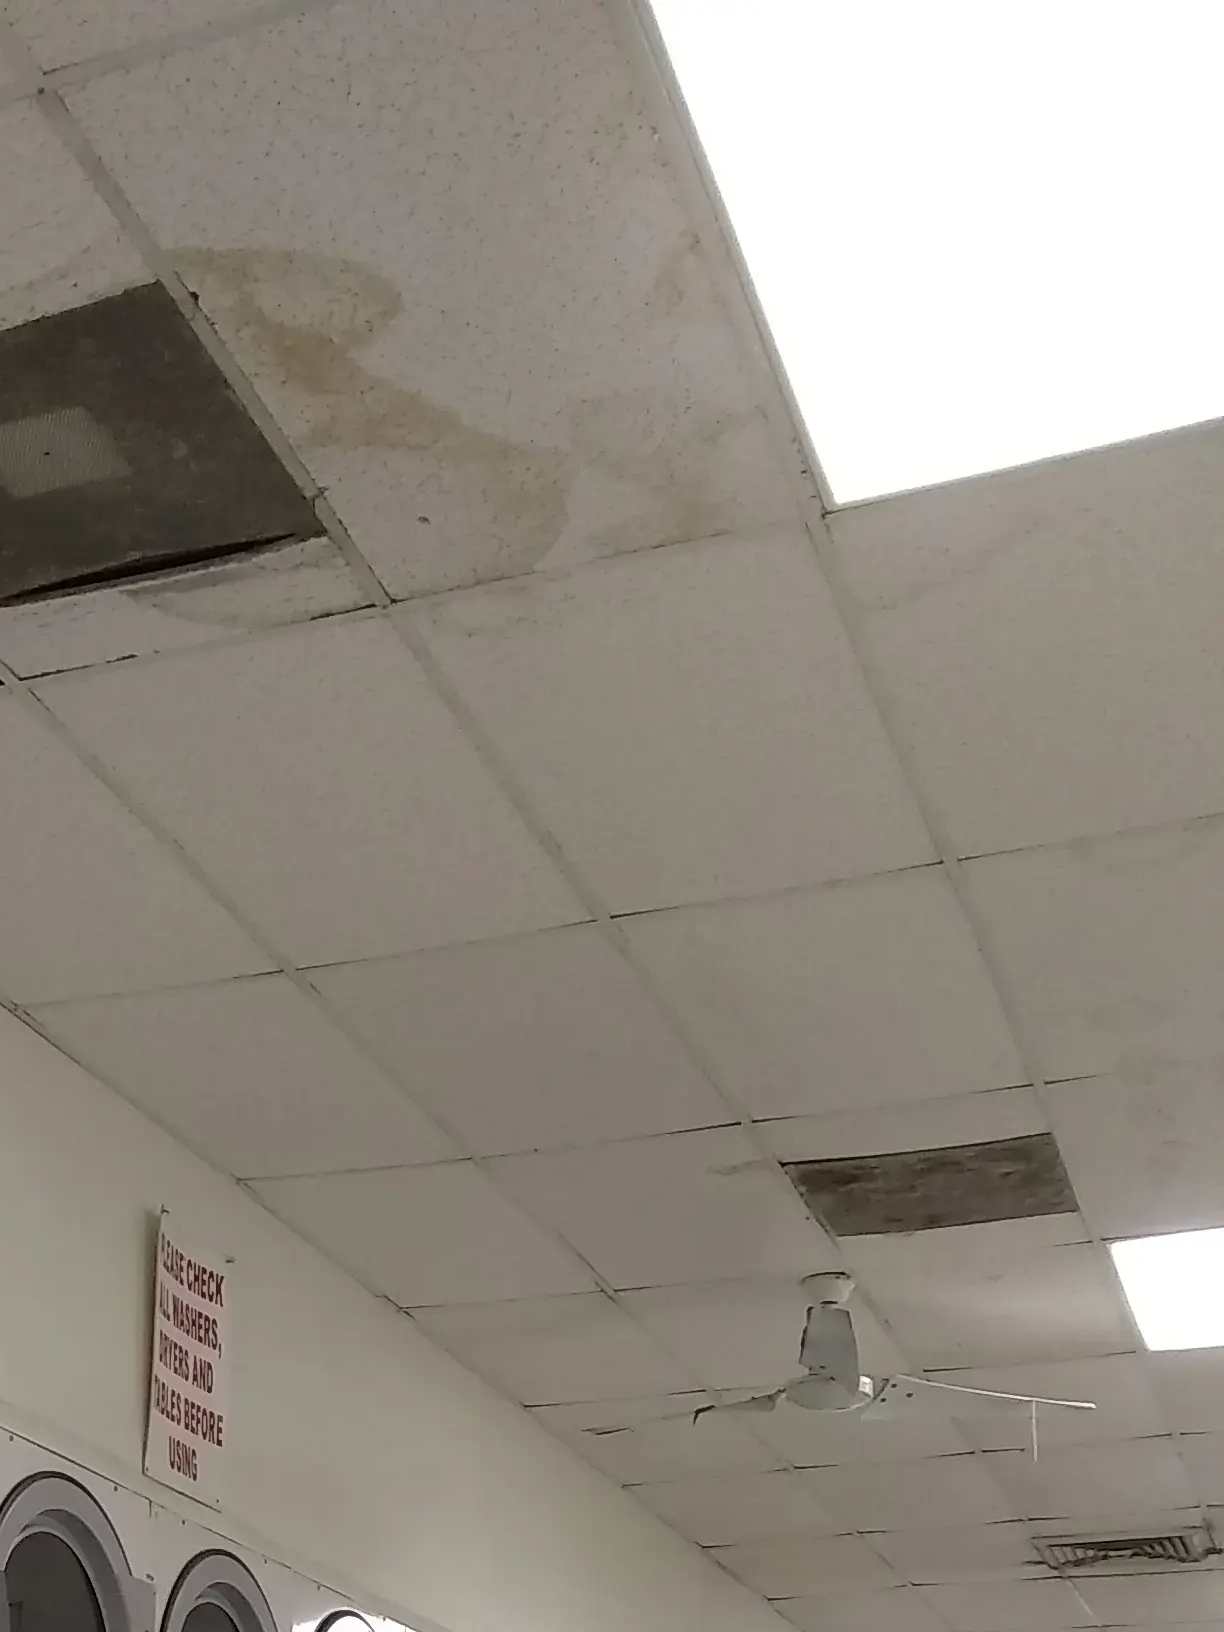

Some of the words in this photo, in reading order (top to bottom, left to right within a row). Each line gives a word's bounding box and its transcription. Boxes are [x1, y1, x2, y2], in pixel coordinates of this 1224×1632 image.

[160, 1232, 185, 1287] PLEASE
[186, 1258, 225, 1308] CHECK
[159, 1278, 171, 1322] ALL
[172, 1292, 222, 1360] WASHERS,
[159, 1328, 189, 1382] DRYERS
[192, 1354, 214, 1394] AND
[154, 1373, 182, 1426] TABLES
[184, 1397, 224, 1448] BEFORE
[169, 1435, 198, 1482] USING
